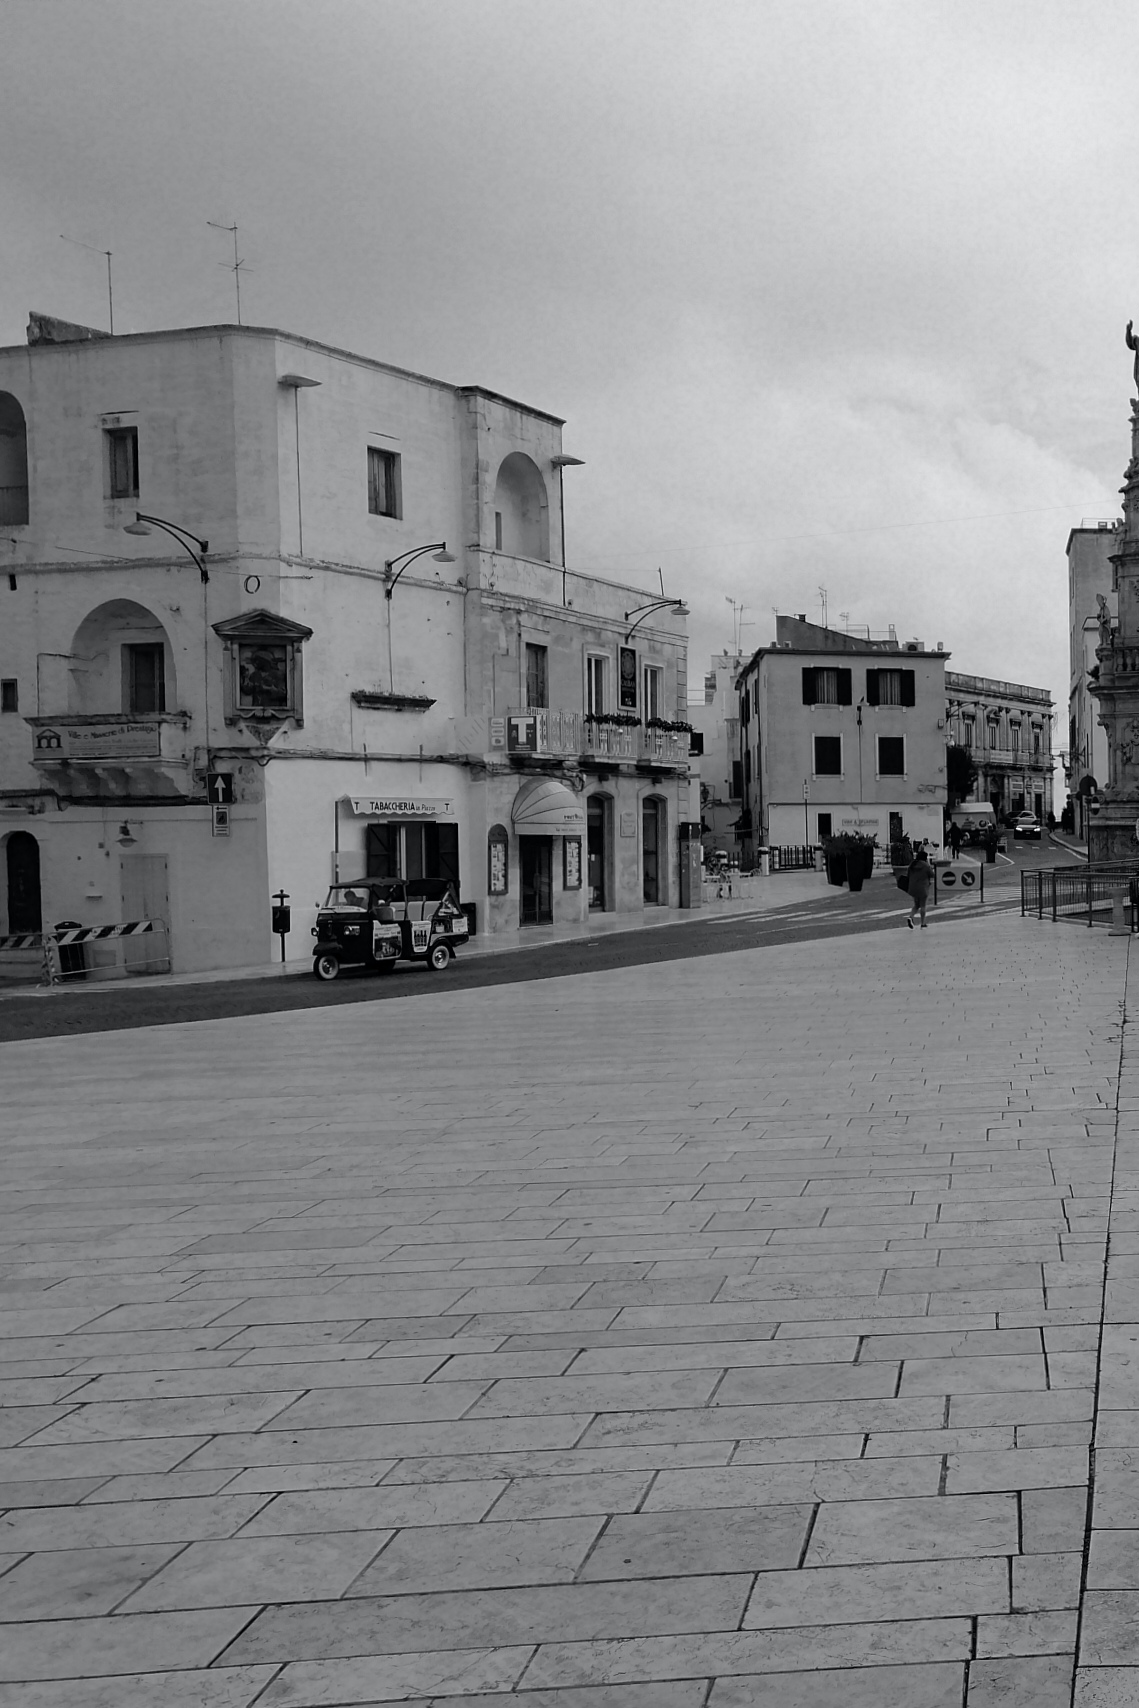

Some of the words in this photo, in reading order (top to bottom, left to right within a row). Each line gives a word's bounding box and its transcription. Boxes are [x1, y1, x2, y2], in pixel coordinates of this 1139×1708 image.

[511, 717, 534, 745] T
[354, 802, 360, 811] T
[370, 802, 416, 811] TABACCHERIA
[445, 803, 450, 811] T
